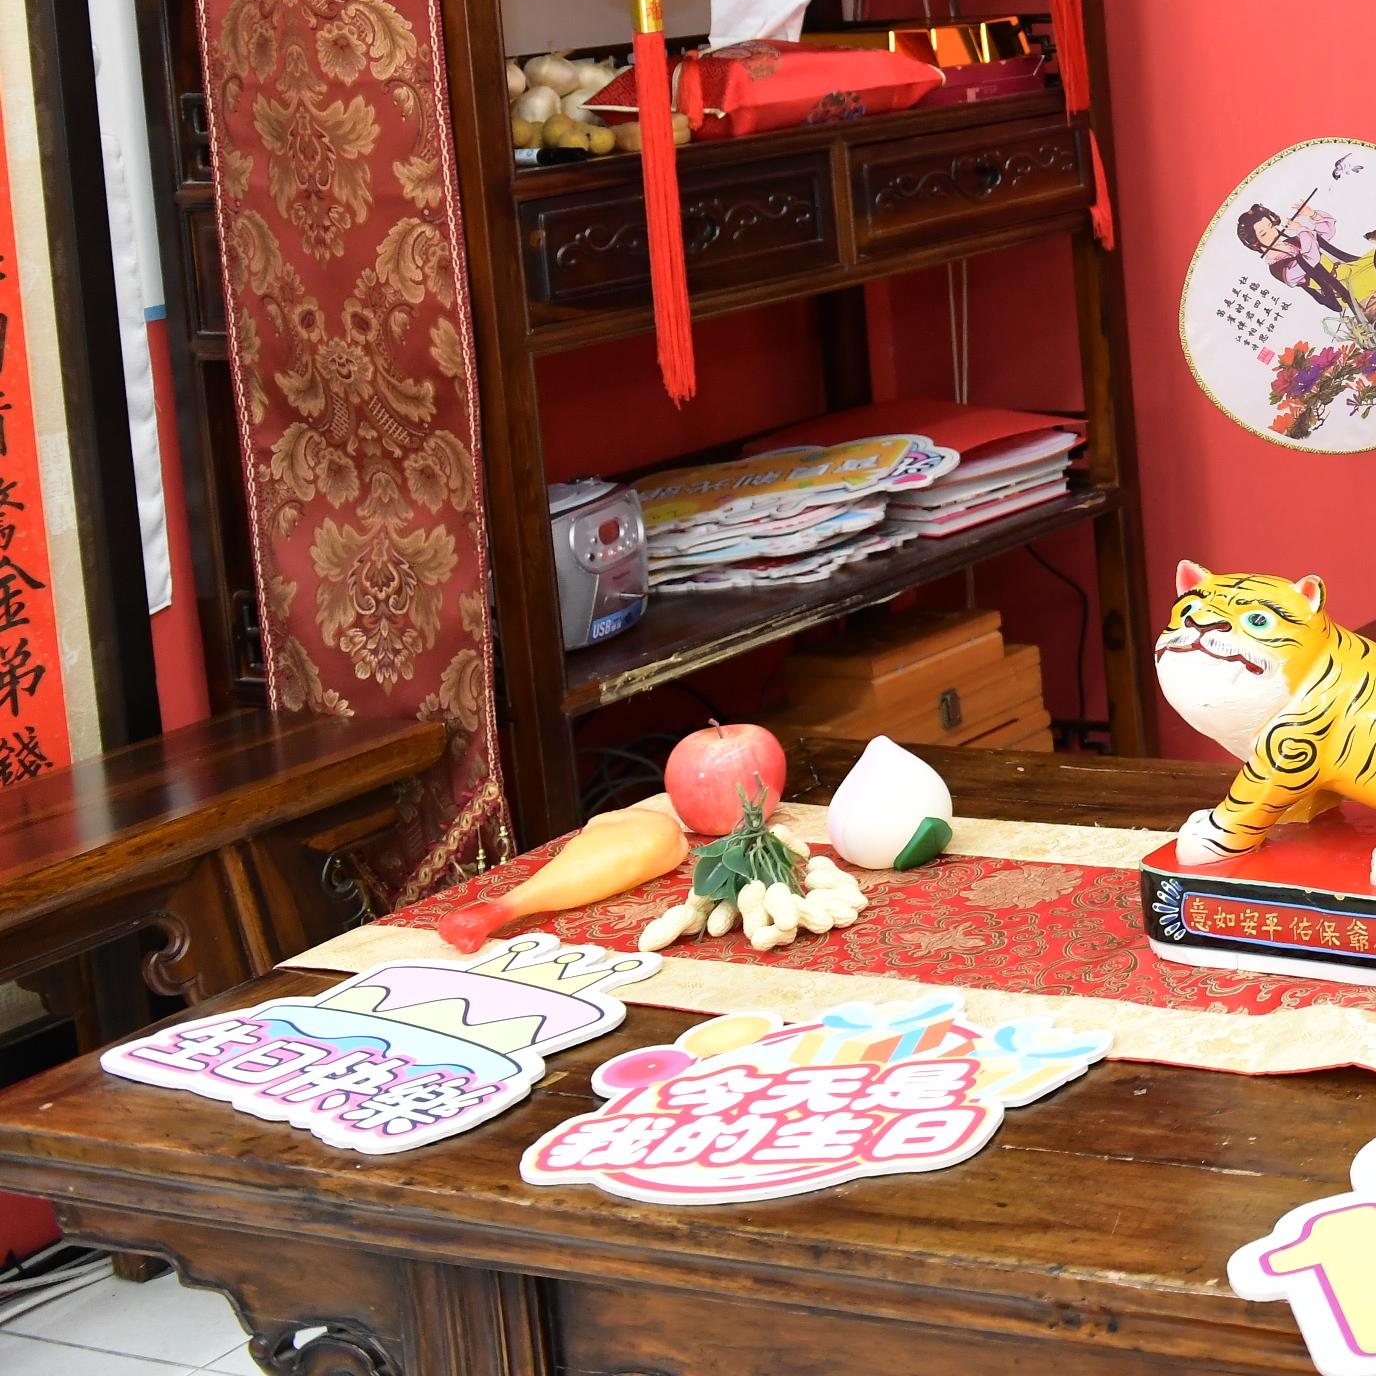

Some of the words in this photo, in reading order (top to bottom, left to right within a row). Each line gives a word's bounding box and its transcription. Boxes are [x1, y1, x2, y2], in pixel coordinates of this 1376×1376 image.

[592, 619, 612, 639] USB
[131, 1018, 501, 1137] 生日快樂
[665, 1064, 973, 1114] 今天是
[547, 1110, 976, 1168] 我的生日
